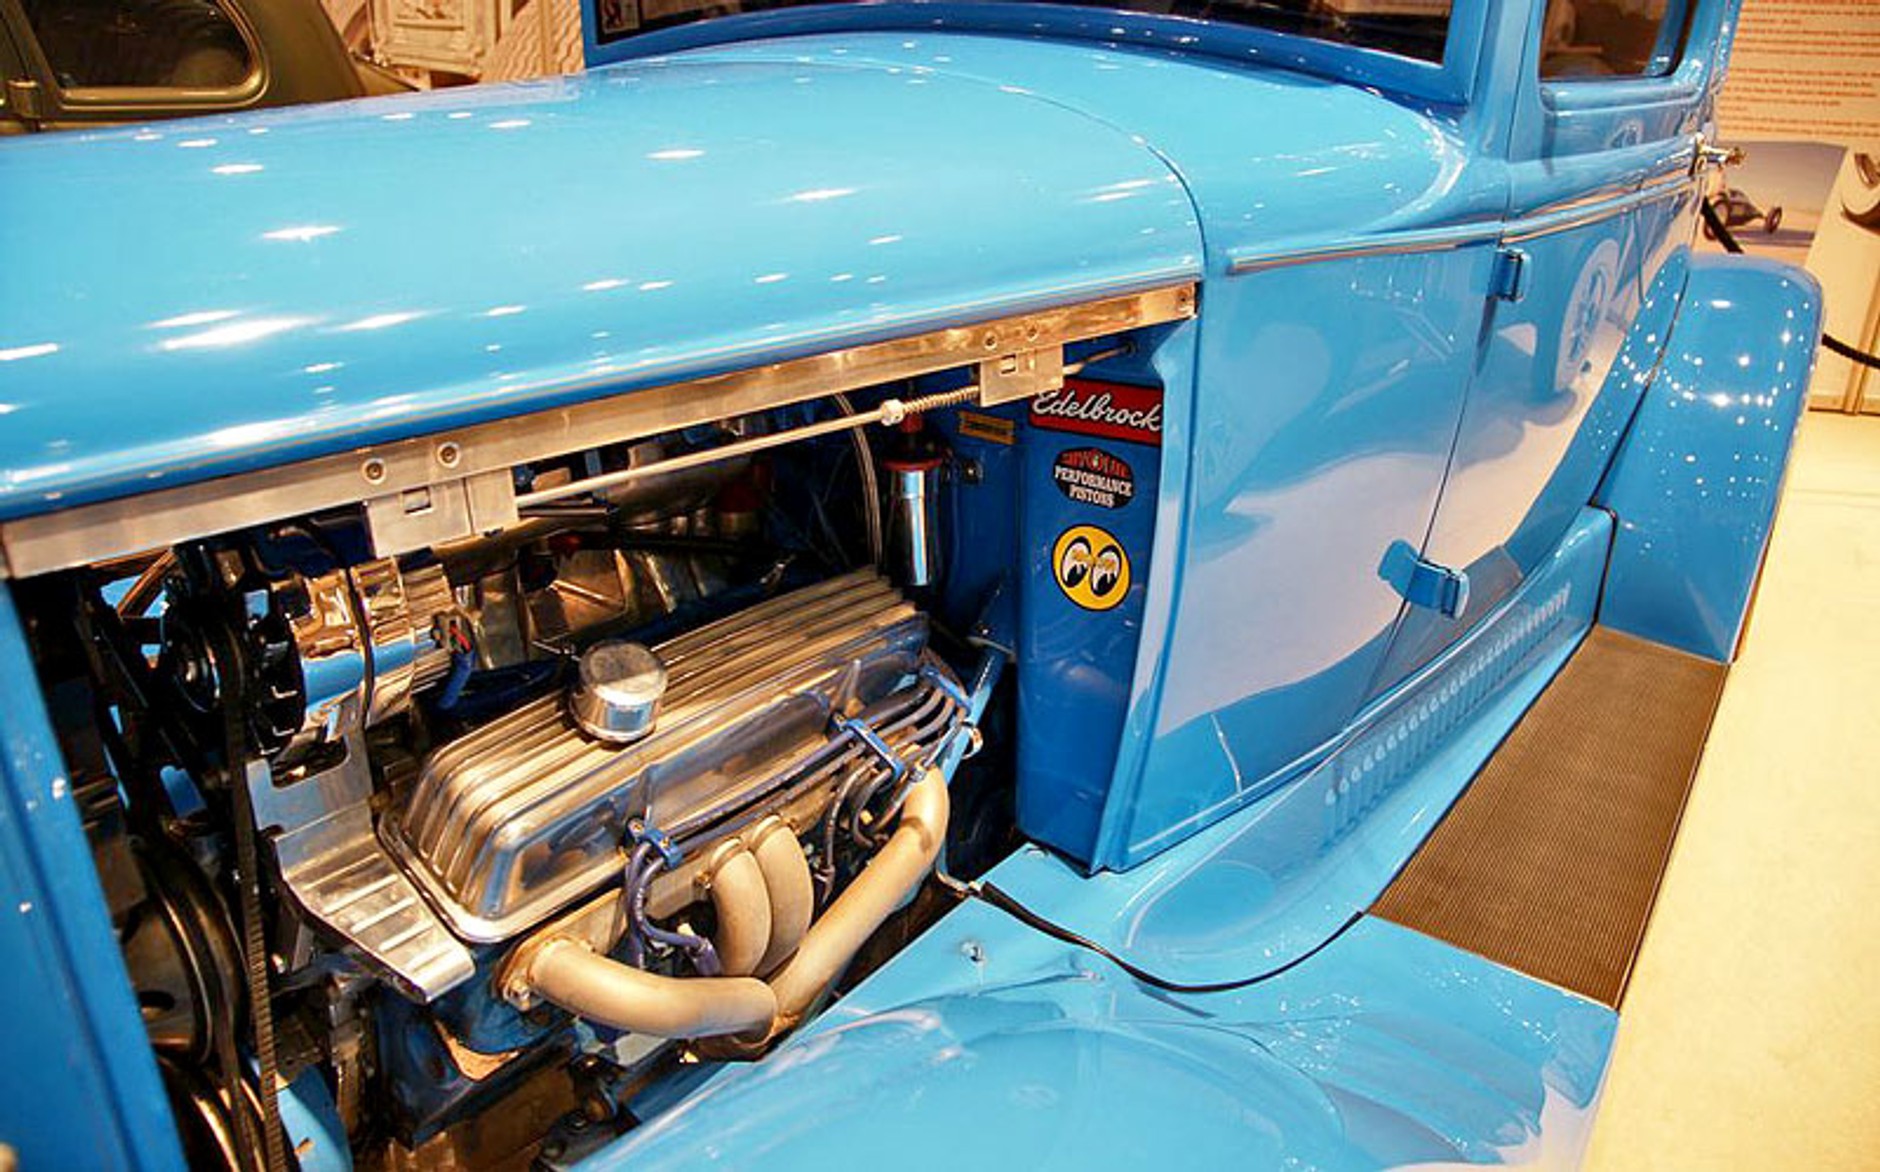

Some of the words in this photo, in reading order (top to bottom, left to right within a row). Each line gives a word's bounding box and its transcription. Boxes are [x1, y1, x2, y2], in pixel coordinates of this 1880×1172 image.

[1032, 389, 1161, 431] Edelbrock
[1054, 465, 1132, 497] PERFORMANCE
[1069, 484, 1115, 507] PISTONS
